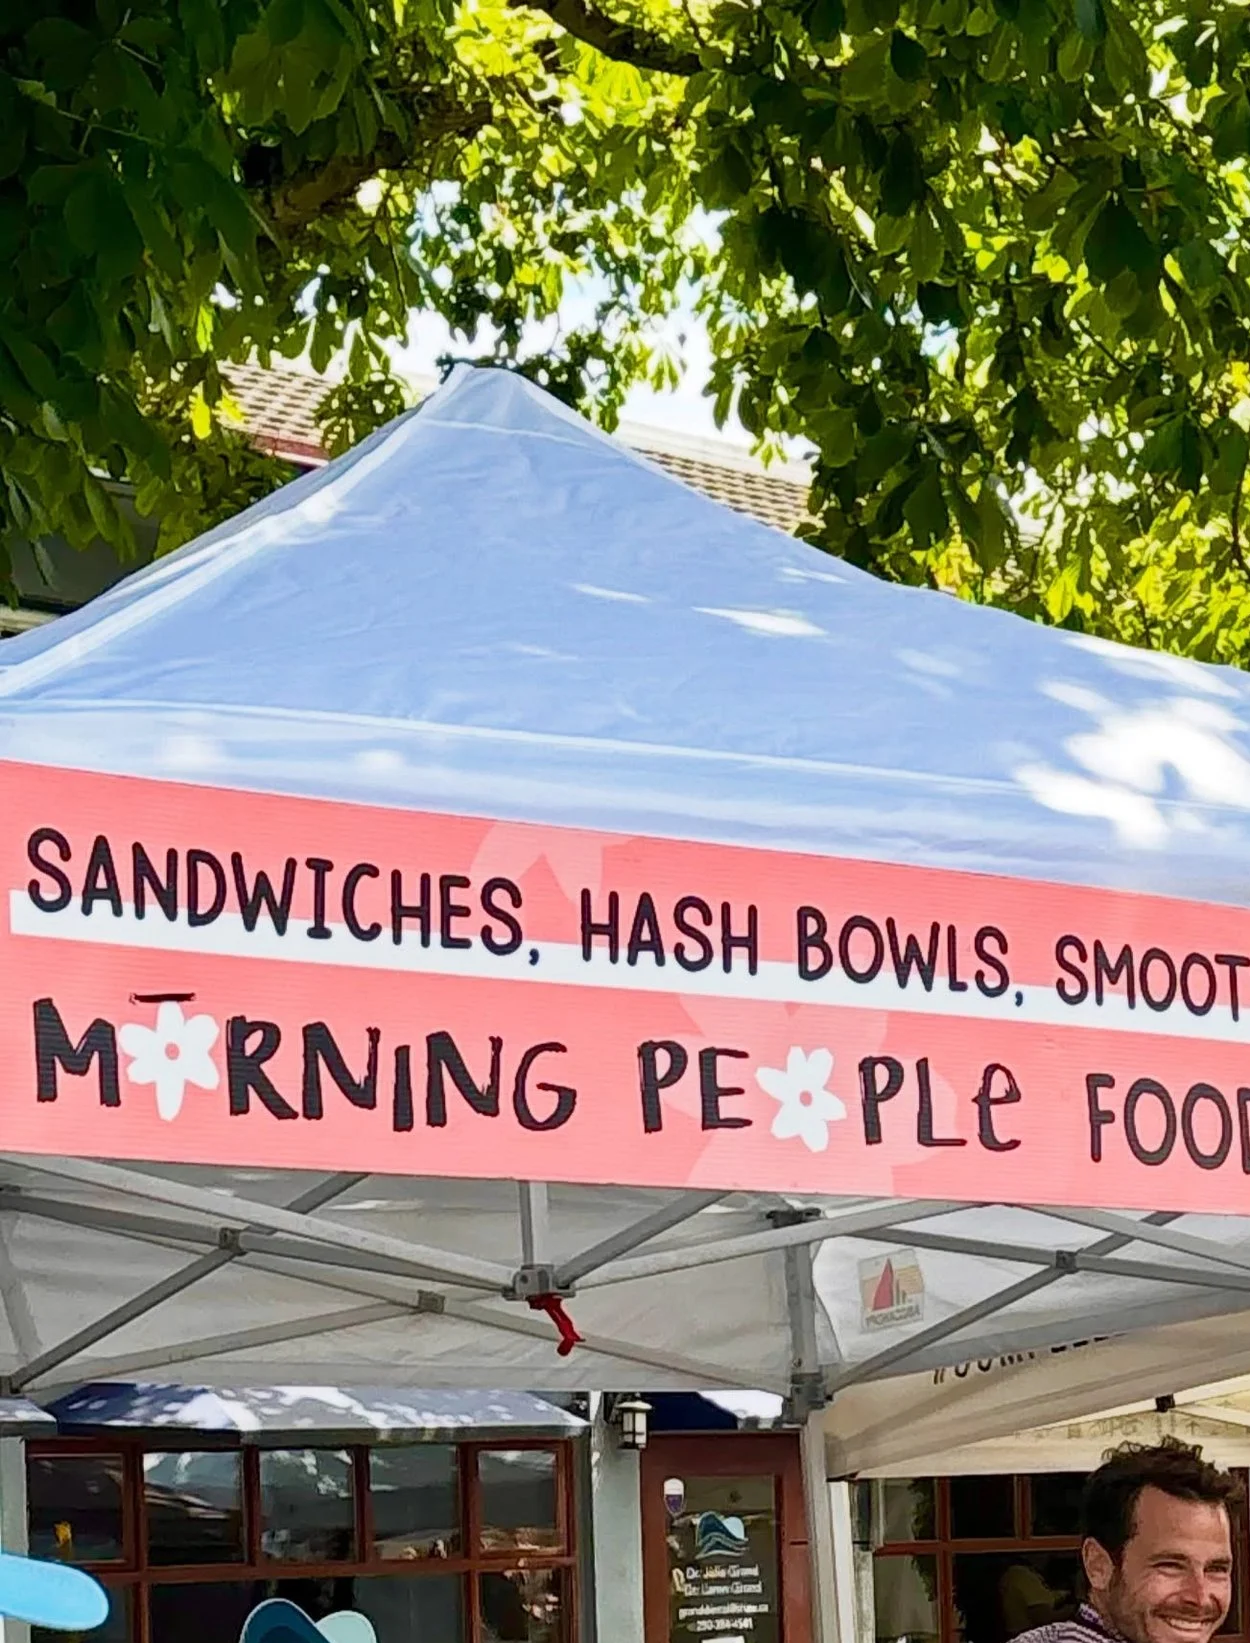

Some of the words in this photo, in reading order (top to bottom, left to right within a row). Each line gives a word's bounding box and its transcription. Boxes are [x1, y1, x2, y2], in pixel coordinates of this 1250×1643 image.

[26, 826, 539, 966] SANDWICHES,
[580, 887, 758, 976] HASH
[796, 905, 1024, 1009] BOWLS,
